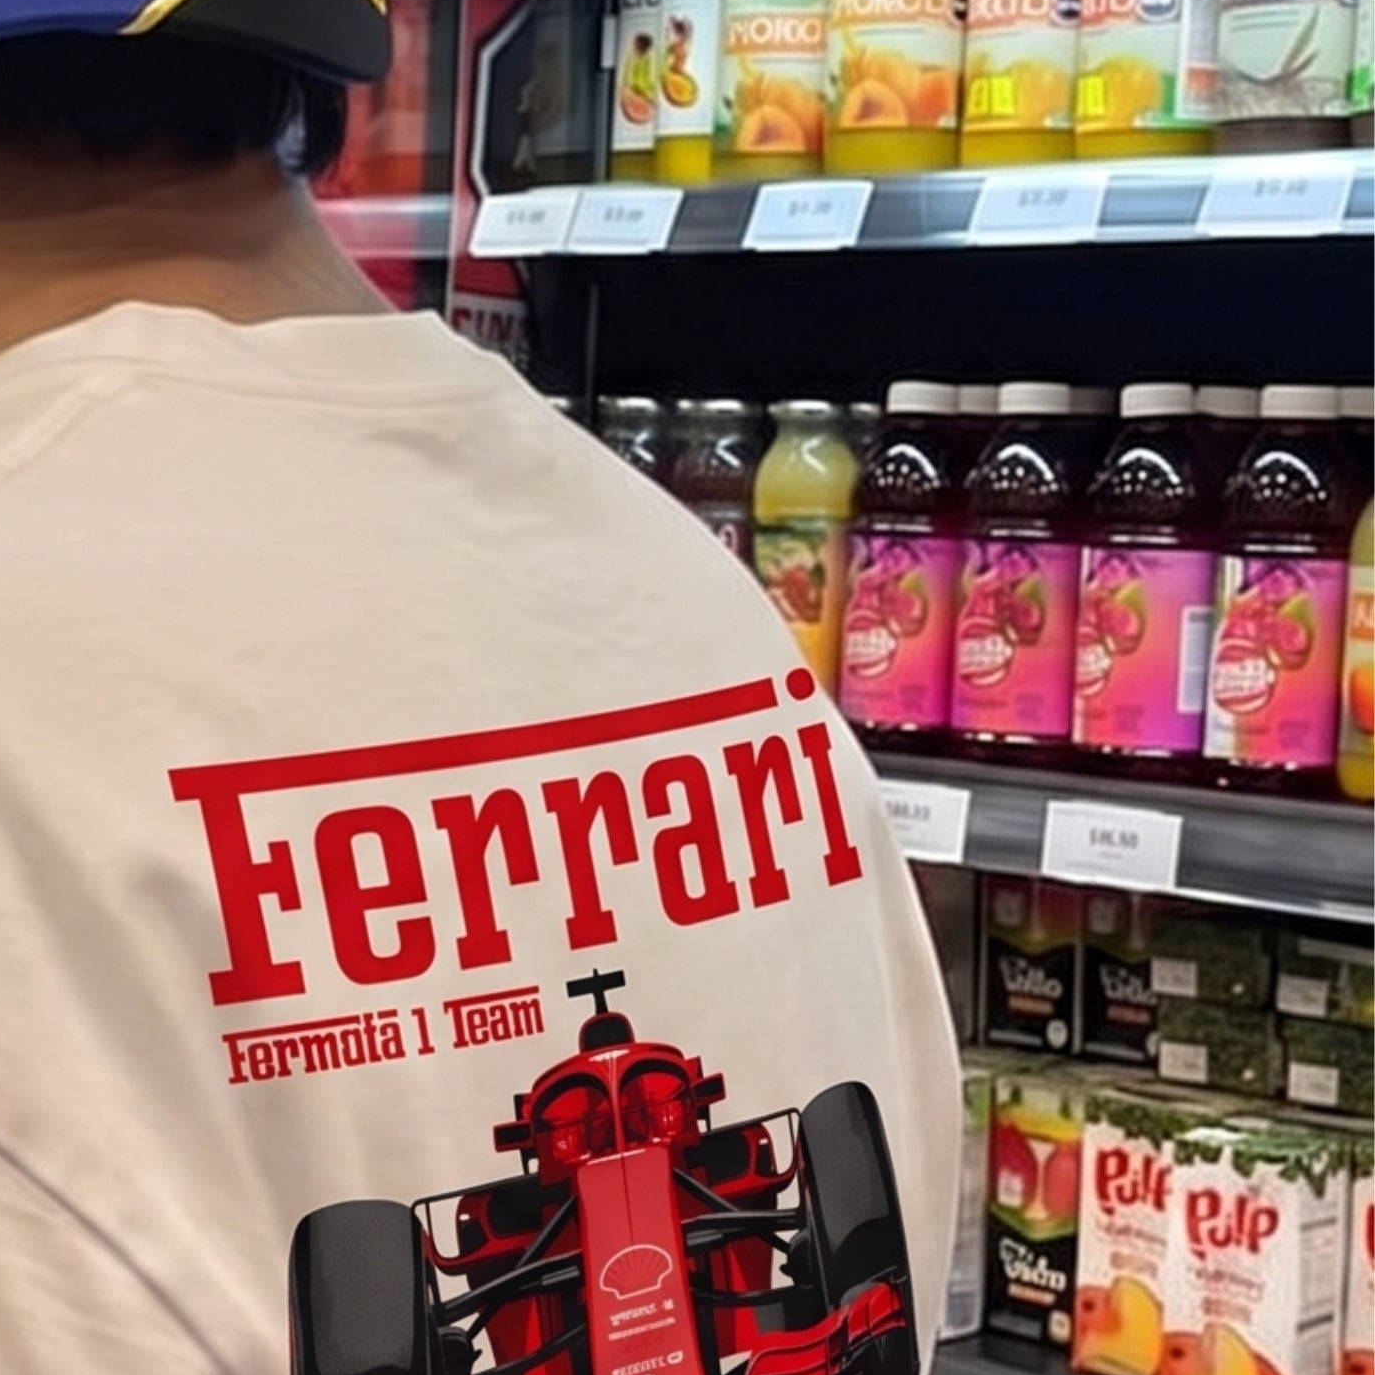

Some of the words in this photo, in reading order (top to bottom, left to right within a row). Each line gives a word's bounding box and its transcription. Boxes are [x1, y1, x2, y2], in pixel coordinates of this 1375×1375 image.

[168, 667, 864, 1007] Ferrari
[411, 1007, 435, 1056] 1
[443, 985, 545, 1049] Team
